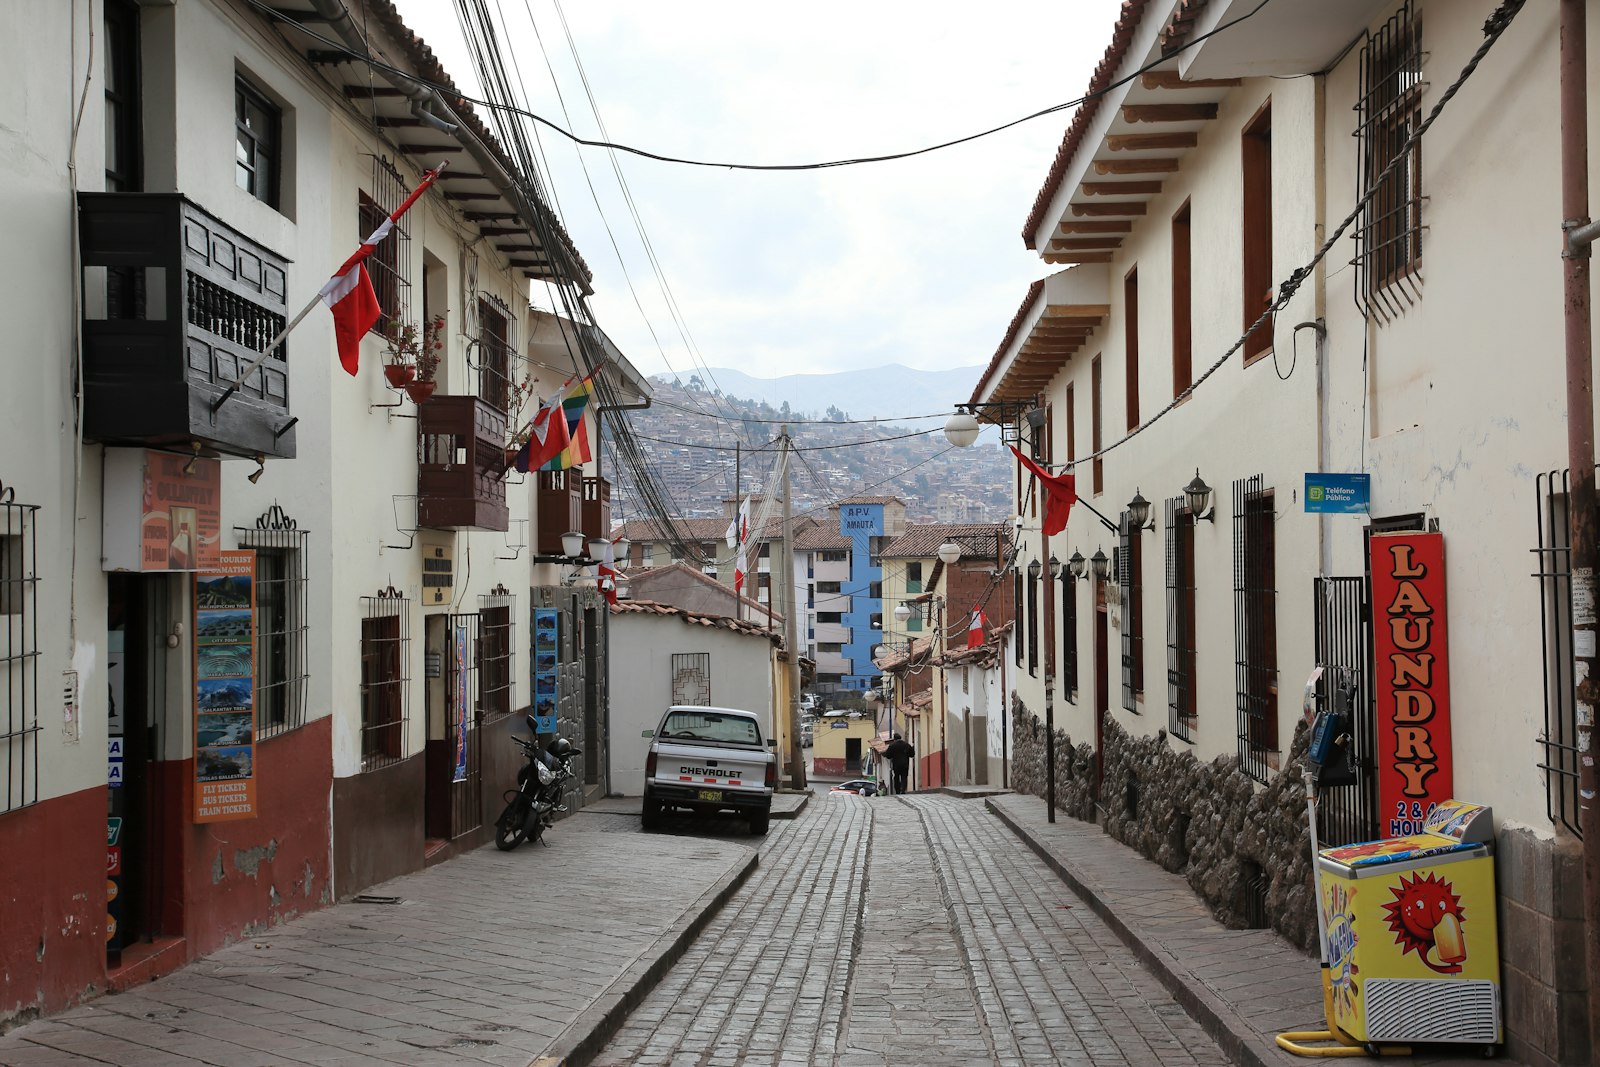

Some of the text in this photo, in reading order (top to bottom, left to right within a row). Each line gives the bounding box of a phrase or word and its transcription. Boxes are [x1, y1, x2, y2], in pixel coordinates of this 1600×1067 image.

[846, 520, 874, 529] AMAUTA
[1386, 544, 1438, 798] LAUNDRY
[680, 766, 742, 778] CHEVROLET
[203, 783, 246, 794] FLY TICKETS
[203, 794, 247, 804] BUS TICKETS
[199, 804, 251, 816] TRAIN TICKETS
[1397, 801, 1406, 818] 2
[1411, 802, 1423, 818] &
[1390, 820, 1424, 836] HOU
